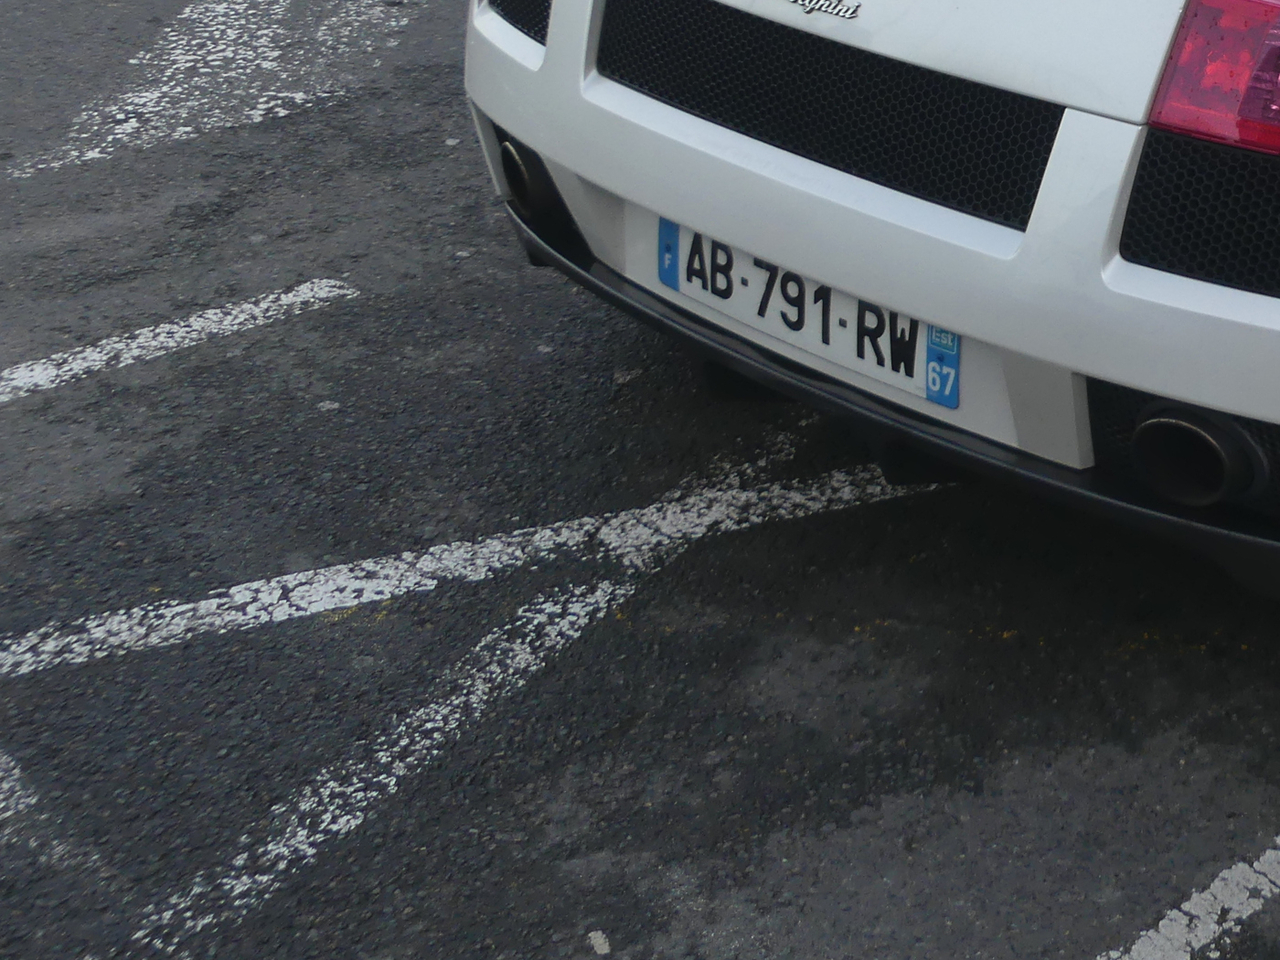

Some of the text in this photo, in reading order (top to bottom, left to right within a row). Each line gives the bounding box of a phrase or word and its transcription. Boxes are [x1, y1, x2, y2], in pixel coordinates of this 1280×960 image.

[664, 254, 673, 268] F
[686, 231, 919, 379] AB-791-RW
[928, 361, 956, 396] 67
